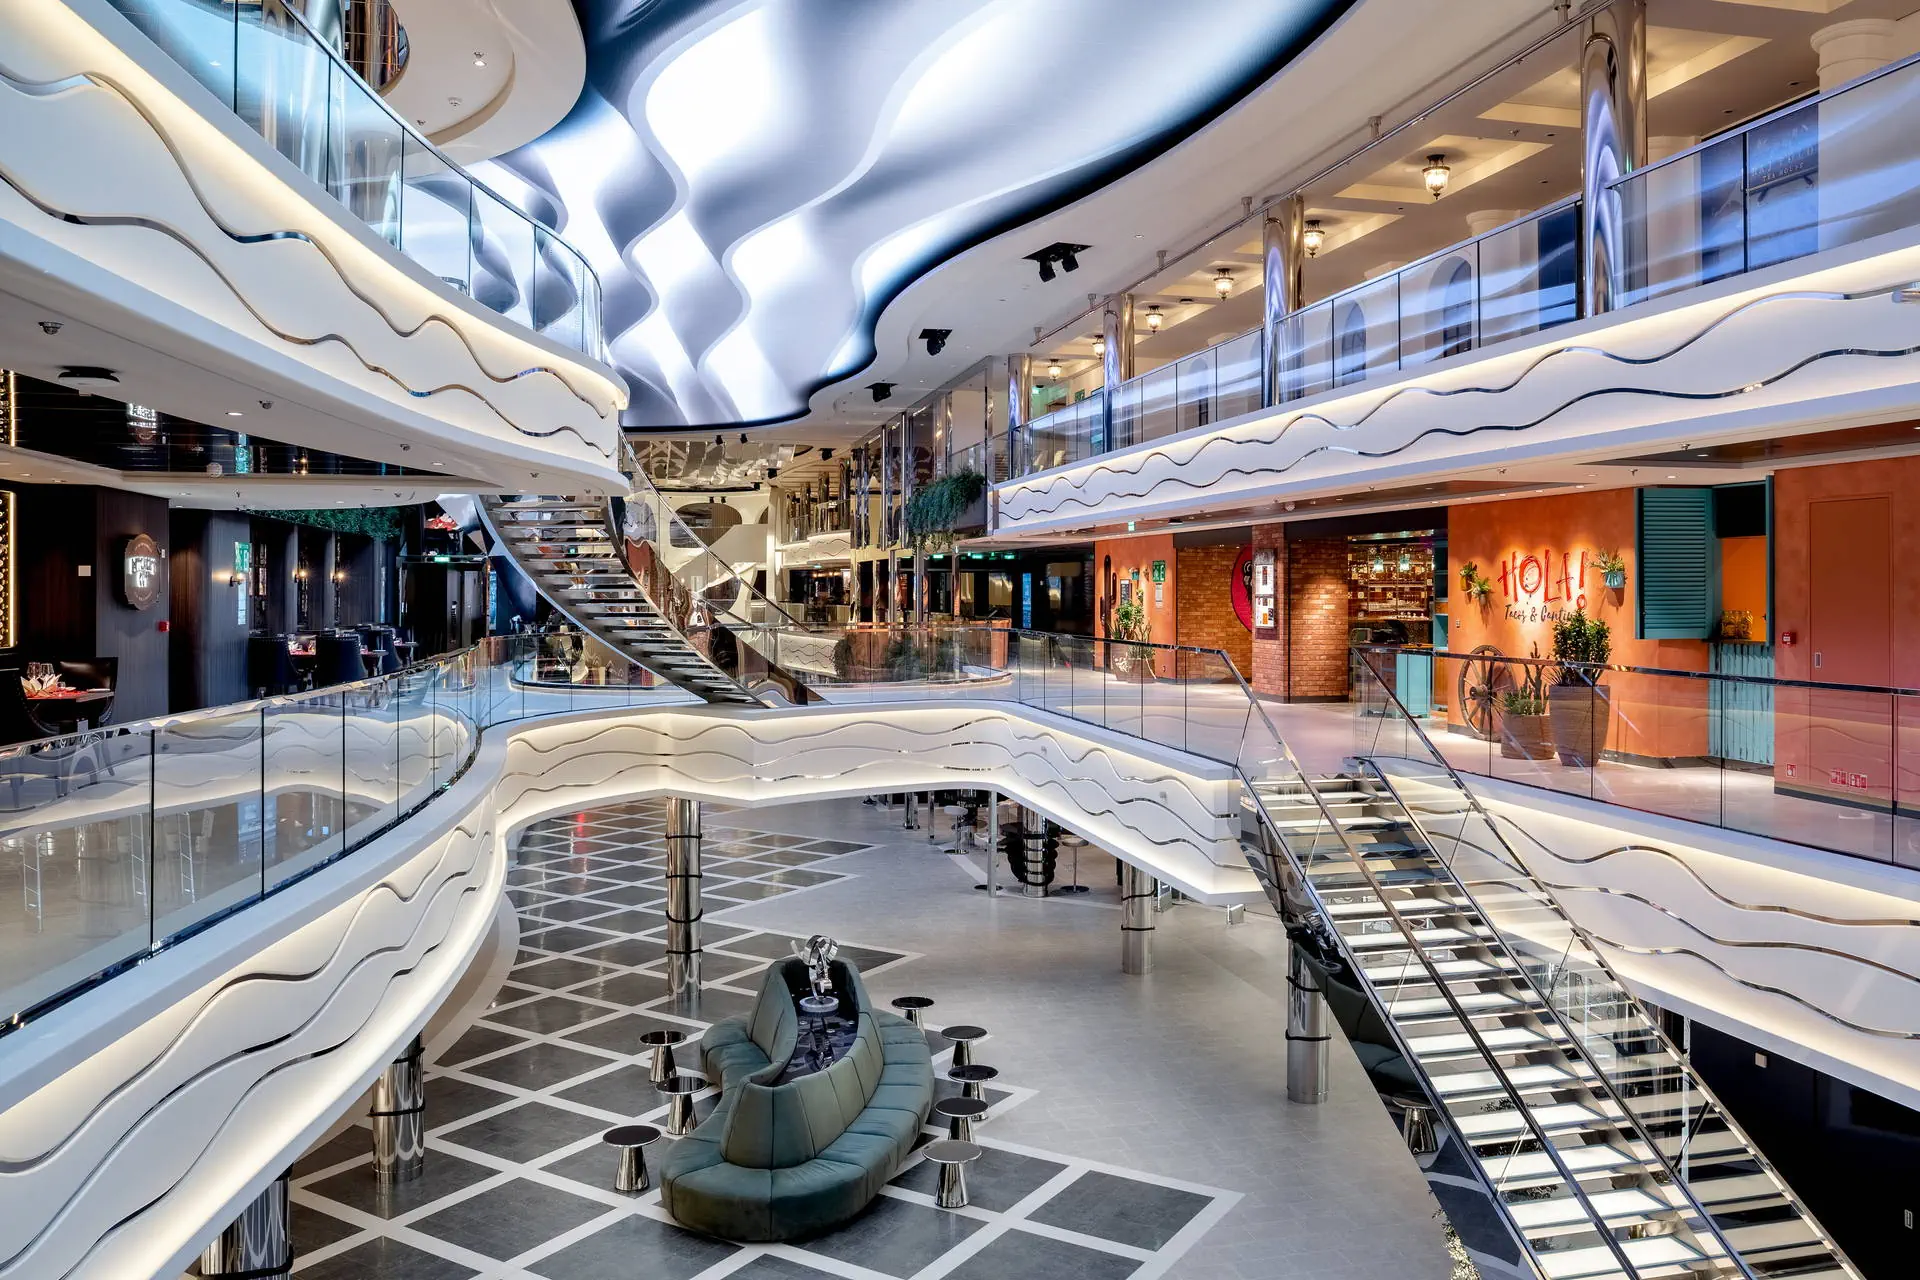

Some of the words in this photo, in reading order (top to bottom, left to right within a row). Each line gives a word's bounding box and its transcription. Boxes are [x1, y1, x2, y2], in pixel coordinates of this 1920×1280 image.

[1497, 549, 1587, 609] HOLA!
[1505, 604, 1525, 623] Tacos
[1530, 606, 1537, 622] &
